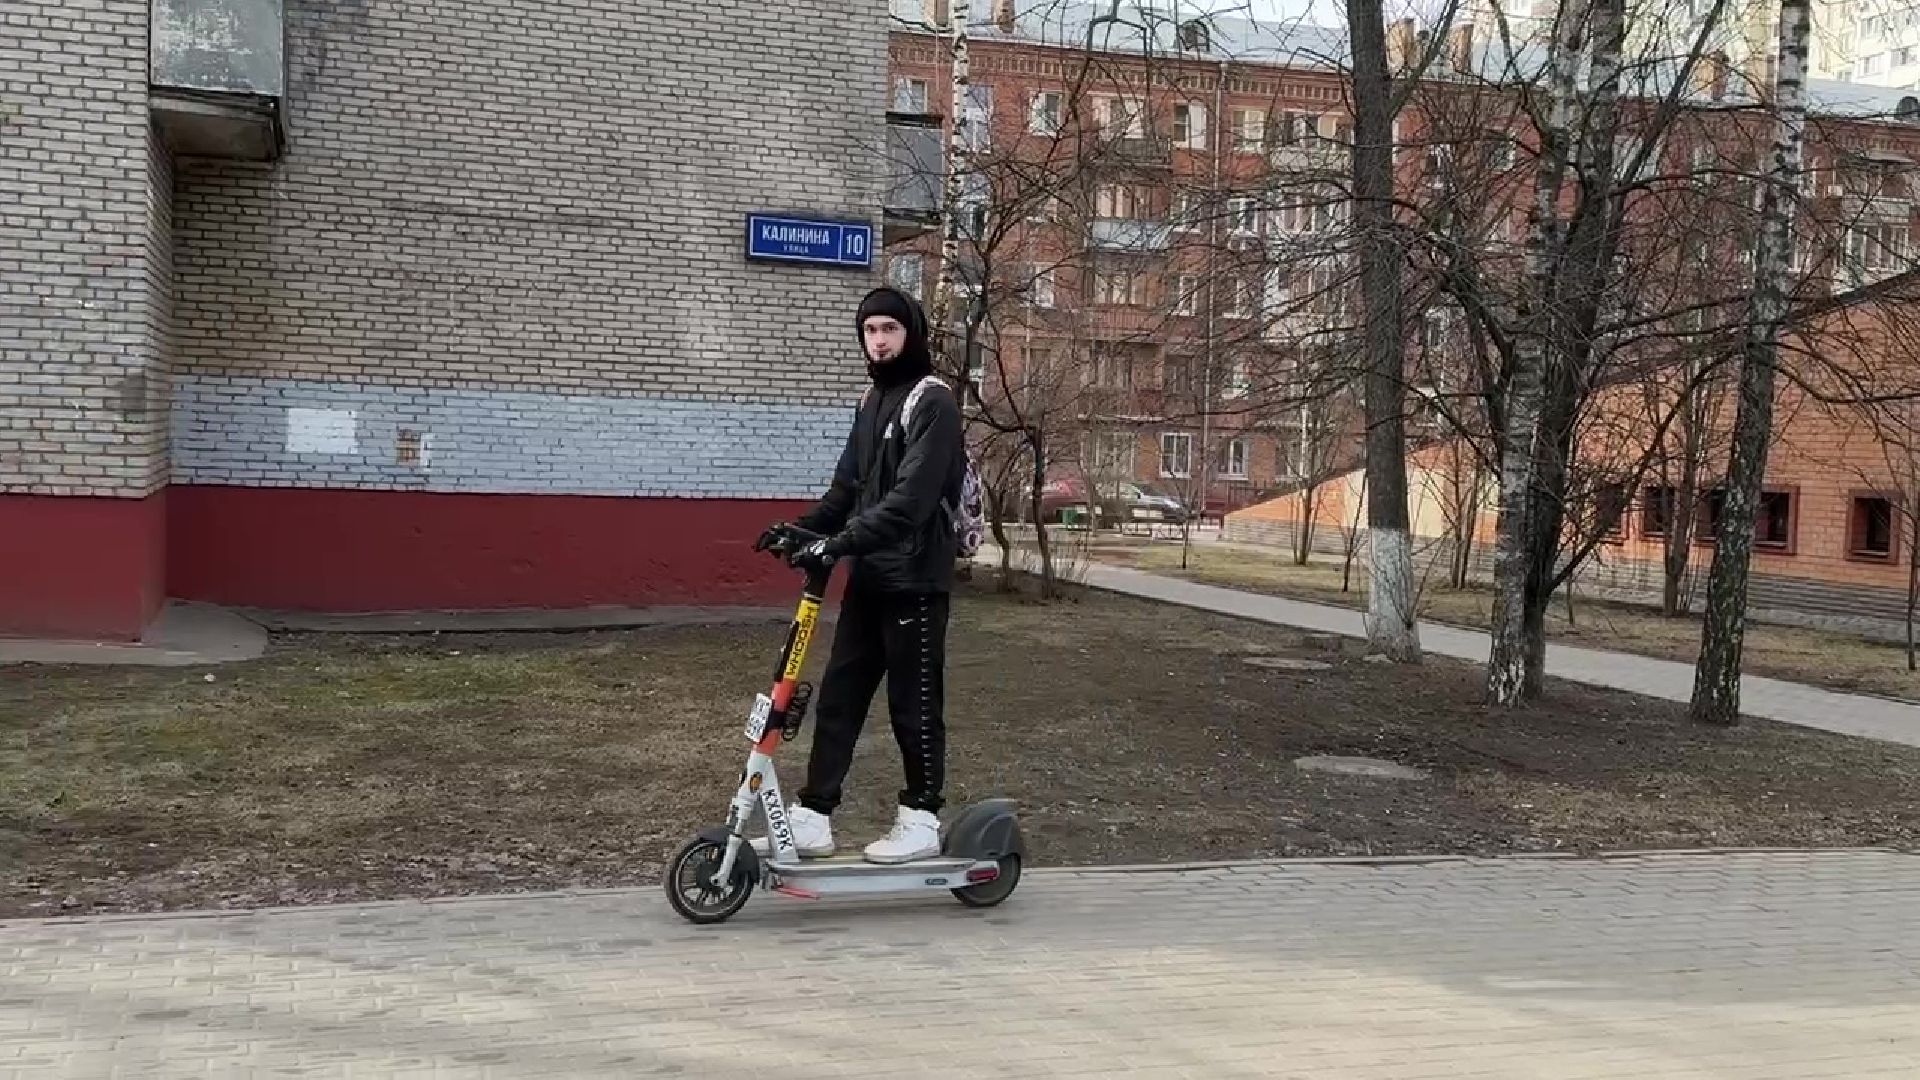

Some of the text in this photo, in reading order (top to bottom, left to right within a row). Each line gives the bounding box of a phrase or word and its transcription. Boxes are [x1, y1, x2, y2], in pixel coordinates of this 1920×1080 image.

[762, 225, 830, 245] КАЛИНИНА
[846, 234, 864, 255] 10
[786, 606, 820, 676] WHOOSH
